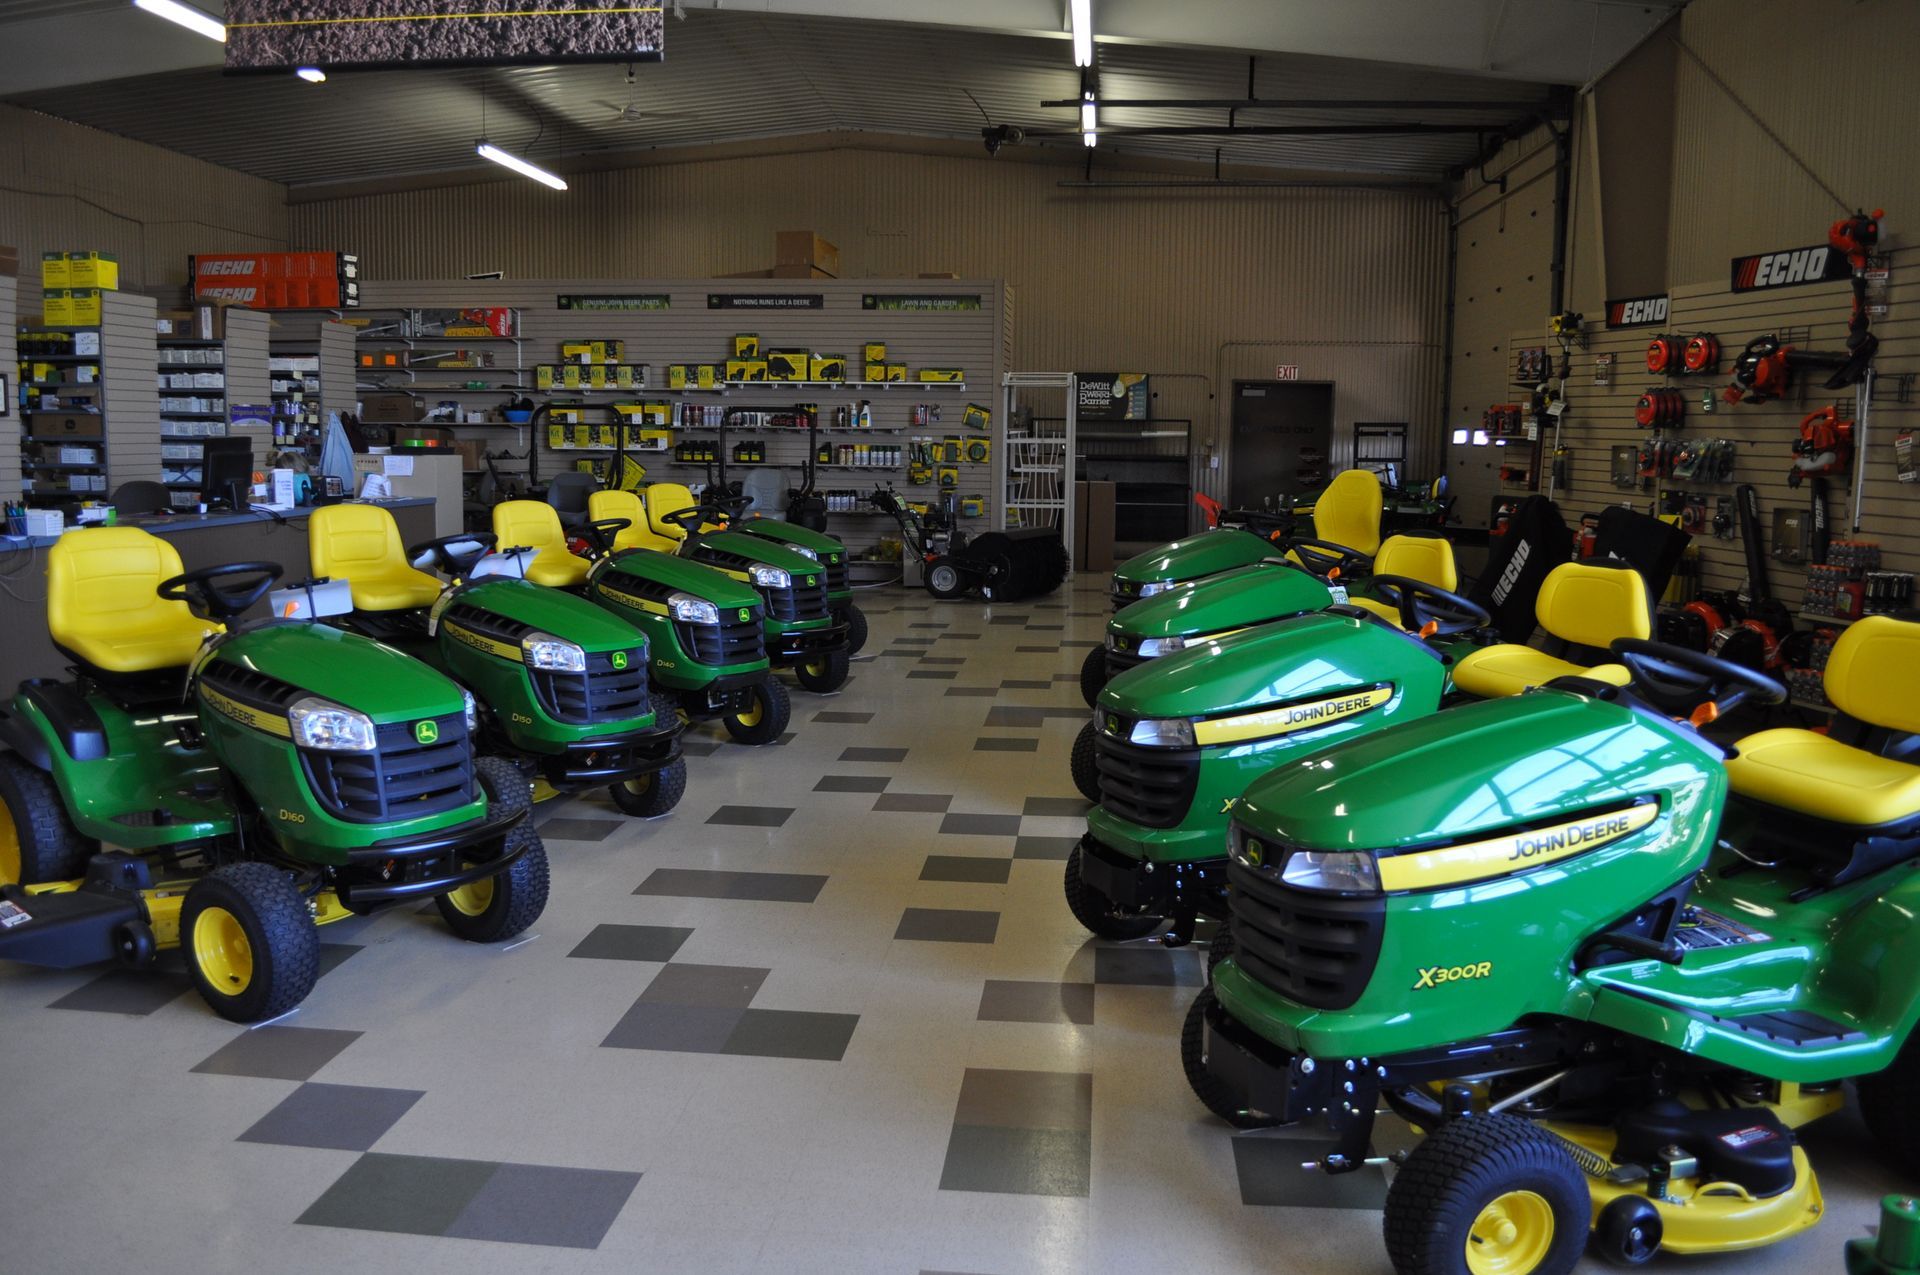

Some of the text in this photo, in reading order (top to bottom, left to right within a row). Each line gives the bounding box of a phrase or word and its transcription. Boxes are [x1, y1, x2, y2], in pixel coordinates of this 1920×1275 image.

[210, 259, 256, 275] ECHO
[1753, 247, 1829, 287] ECHO
[607, 298, 623, 306] JOHN
[624, 298, 641, 306] DEERE
[642, 298, 660, 306] PARTS
[733, 298, 758, 307] NOTHING
[759, 298, 775, 307] RUNS
[775, 298, 787, 307] LIKE
[793, 298, 810, 307] DEERE
[901, 299, 958, 307] LAWN AND GARDEN
[1621, 297, 1668, 324] ECHO
[1277, 366, 1298, 380] EXIT
[1079, 381, 1111, 391] DeWitt
[1079, 393, 1112, 405] Barrier
[1499, 538, 1530, 595] ECHO
[469, 635, 495, 653] DEERE
[228, 702, 256, 726] DEERE
[1285, 696, 1370, 725] JOHN DEERE
[279, 808, 305, 823] D160
[1508, 815, 1630, 861] JOHN DEERE
[1412, 961, 1492, 990] X300R
